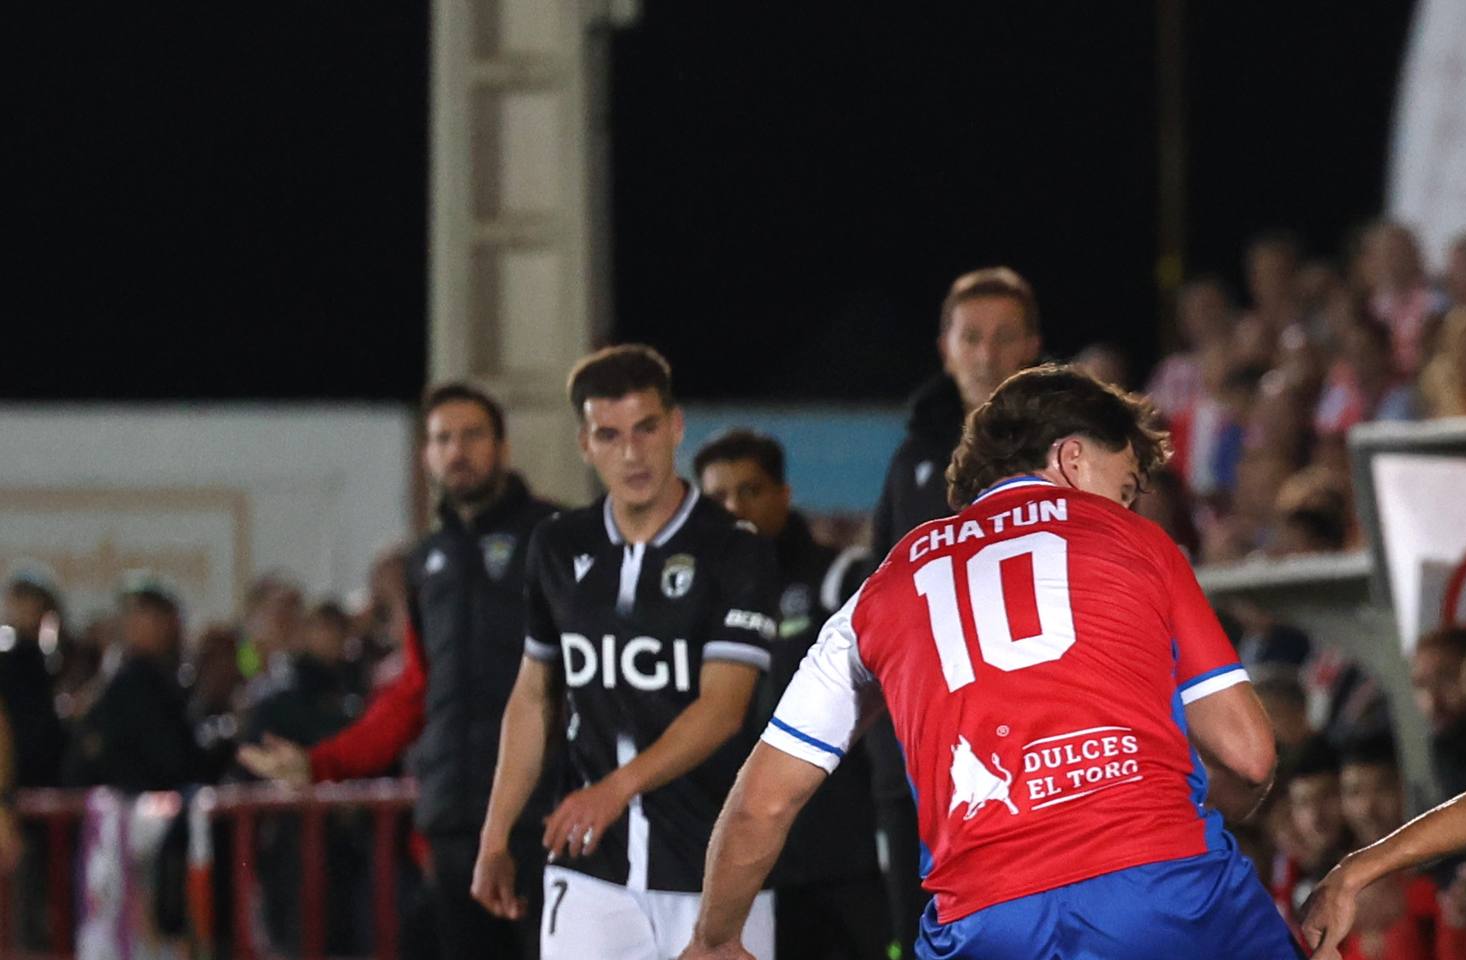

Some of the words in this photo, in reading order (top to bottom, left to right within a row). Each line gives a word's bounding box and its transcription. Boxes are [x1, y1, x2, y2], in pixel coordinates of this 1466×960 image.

[912, 530, 1077, 694] 10
[560, 632, 691, 692] DIGI
[1023, 735, 1138, 773] DULCES
[1026, 776, 1062, 800] EL
[550, 881, 568, 935] 7
